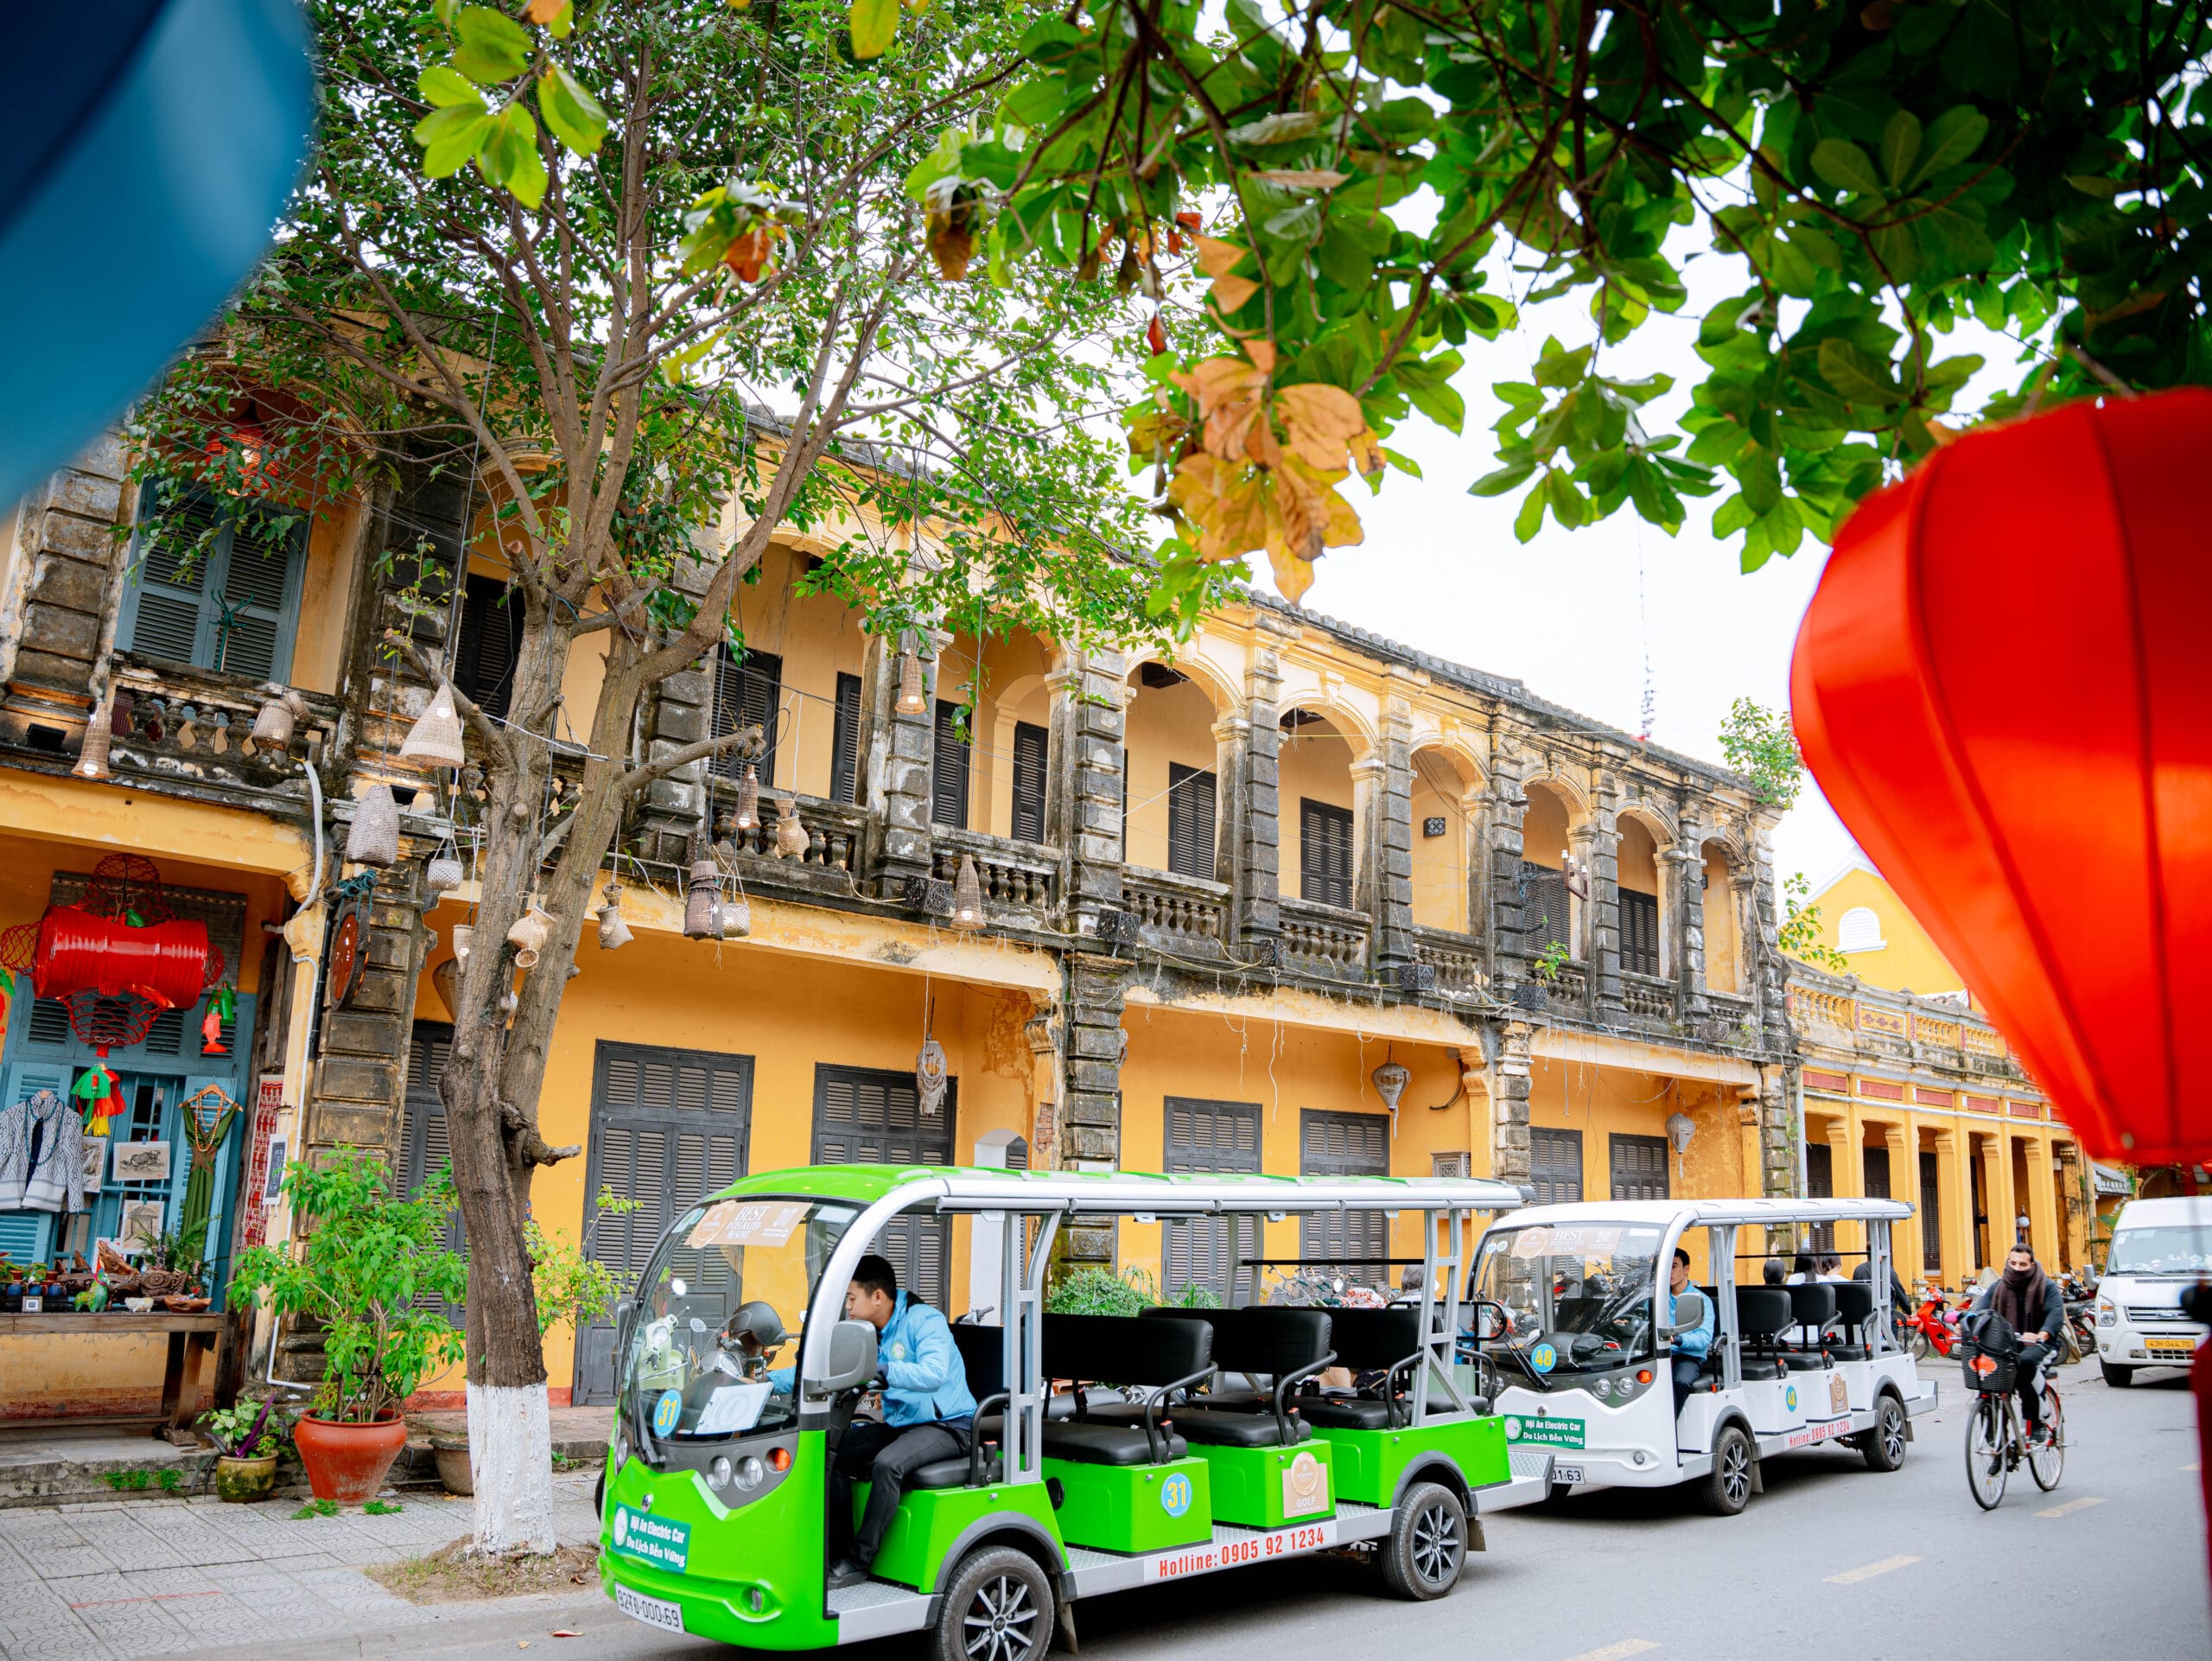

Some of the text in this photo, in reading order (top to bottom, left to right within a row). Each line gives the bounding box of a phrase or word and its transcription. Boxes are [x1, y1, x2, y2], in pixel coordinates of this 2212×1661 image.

[734, 1205, 772, 1221] BEST
[1554, 1230, 1585, 1240] BEST
[1535, 1349, 1553, 1366] 48
[1788, 1391, 1796, 1406] 48
[658, 1398, 678, 1427] 31
[1535, 1420, 1543, 1429] An
[1544, 1421, 1568, 1430] Electric
[1569, 1422, 1581, 1431] Car
[1811, 1426, 1826, 1441] 0905
[1827, 1423, 1834, 1436] 92
[1836, 1421, 1850, 1434] 1234
[1167, 1481, 1186, 1507] 31
[1296, 1496, 1316, 1507] GOLF
[639, 1518, 647, 1533] An
[647, 1521, 671, 1540] Electric
[671, 1528, 685, 1544] Car
[626, 1535, 635, 1549] Du
[1159, 1527, 1325, 1577] Hotline: 0905 92 1234
